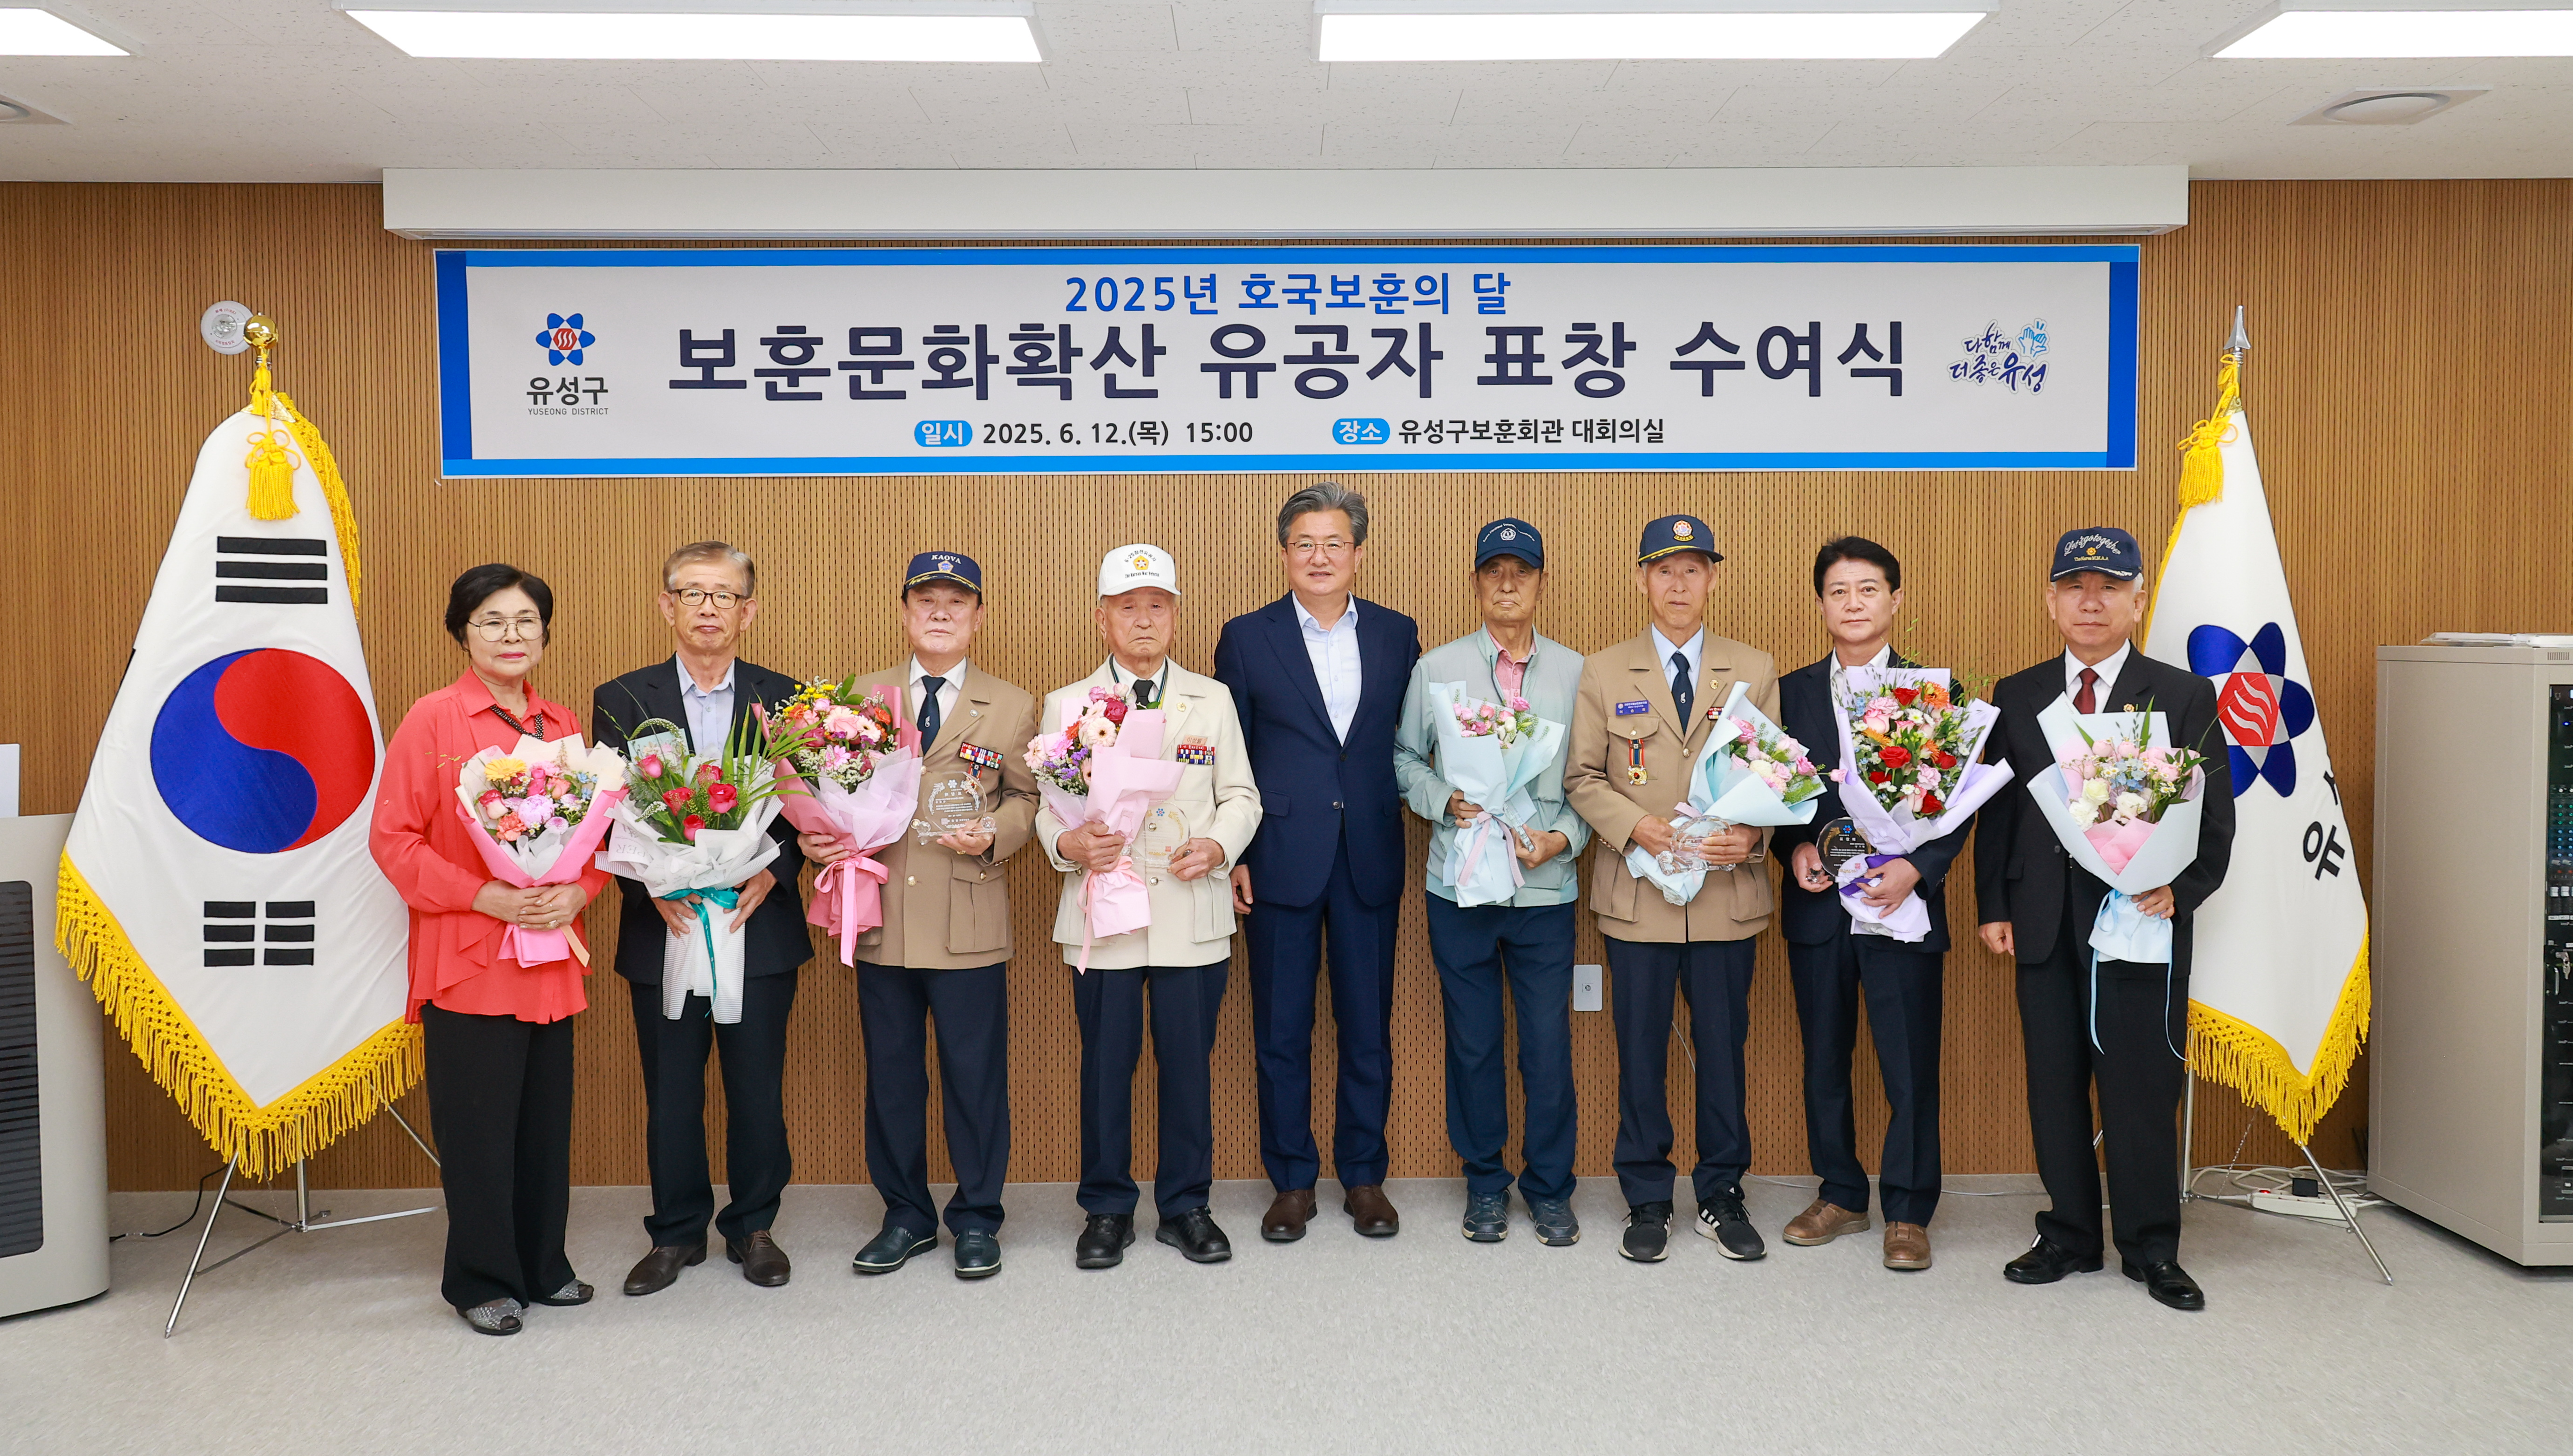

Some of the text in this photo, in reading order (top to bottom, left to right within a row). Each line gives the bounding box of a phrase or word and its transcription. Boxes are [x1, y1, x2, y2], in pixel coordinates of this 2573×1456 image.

[1066, 273, 1511, 315] 2025년 호국보훈의 달
[1964, 322, 2011, 354] 다함께
[669, 321, 1904, 401] 보훈문화확산 유공자 표창 수여식
[1949, 352, 2047, 393] 더 좋은 유성
[526, 376, 609, 406] 유성구
[921, 422, 963, 445] 일시
[984, 424, 1050, 445] 2025.
[1060, 423, 1080, 445] 6.
[1187, 422, 1252, 443] 15:00
[1338, 420, 1384, 442] 장소
[1399, 419, 1663, 444] 유성구보훈회관 대회의실
[931, 555, 961, 564] KAOVA
